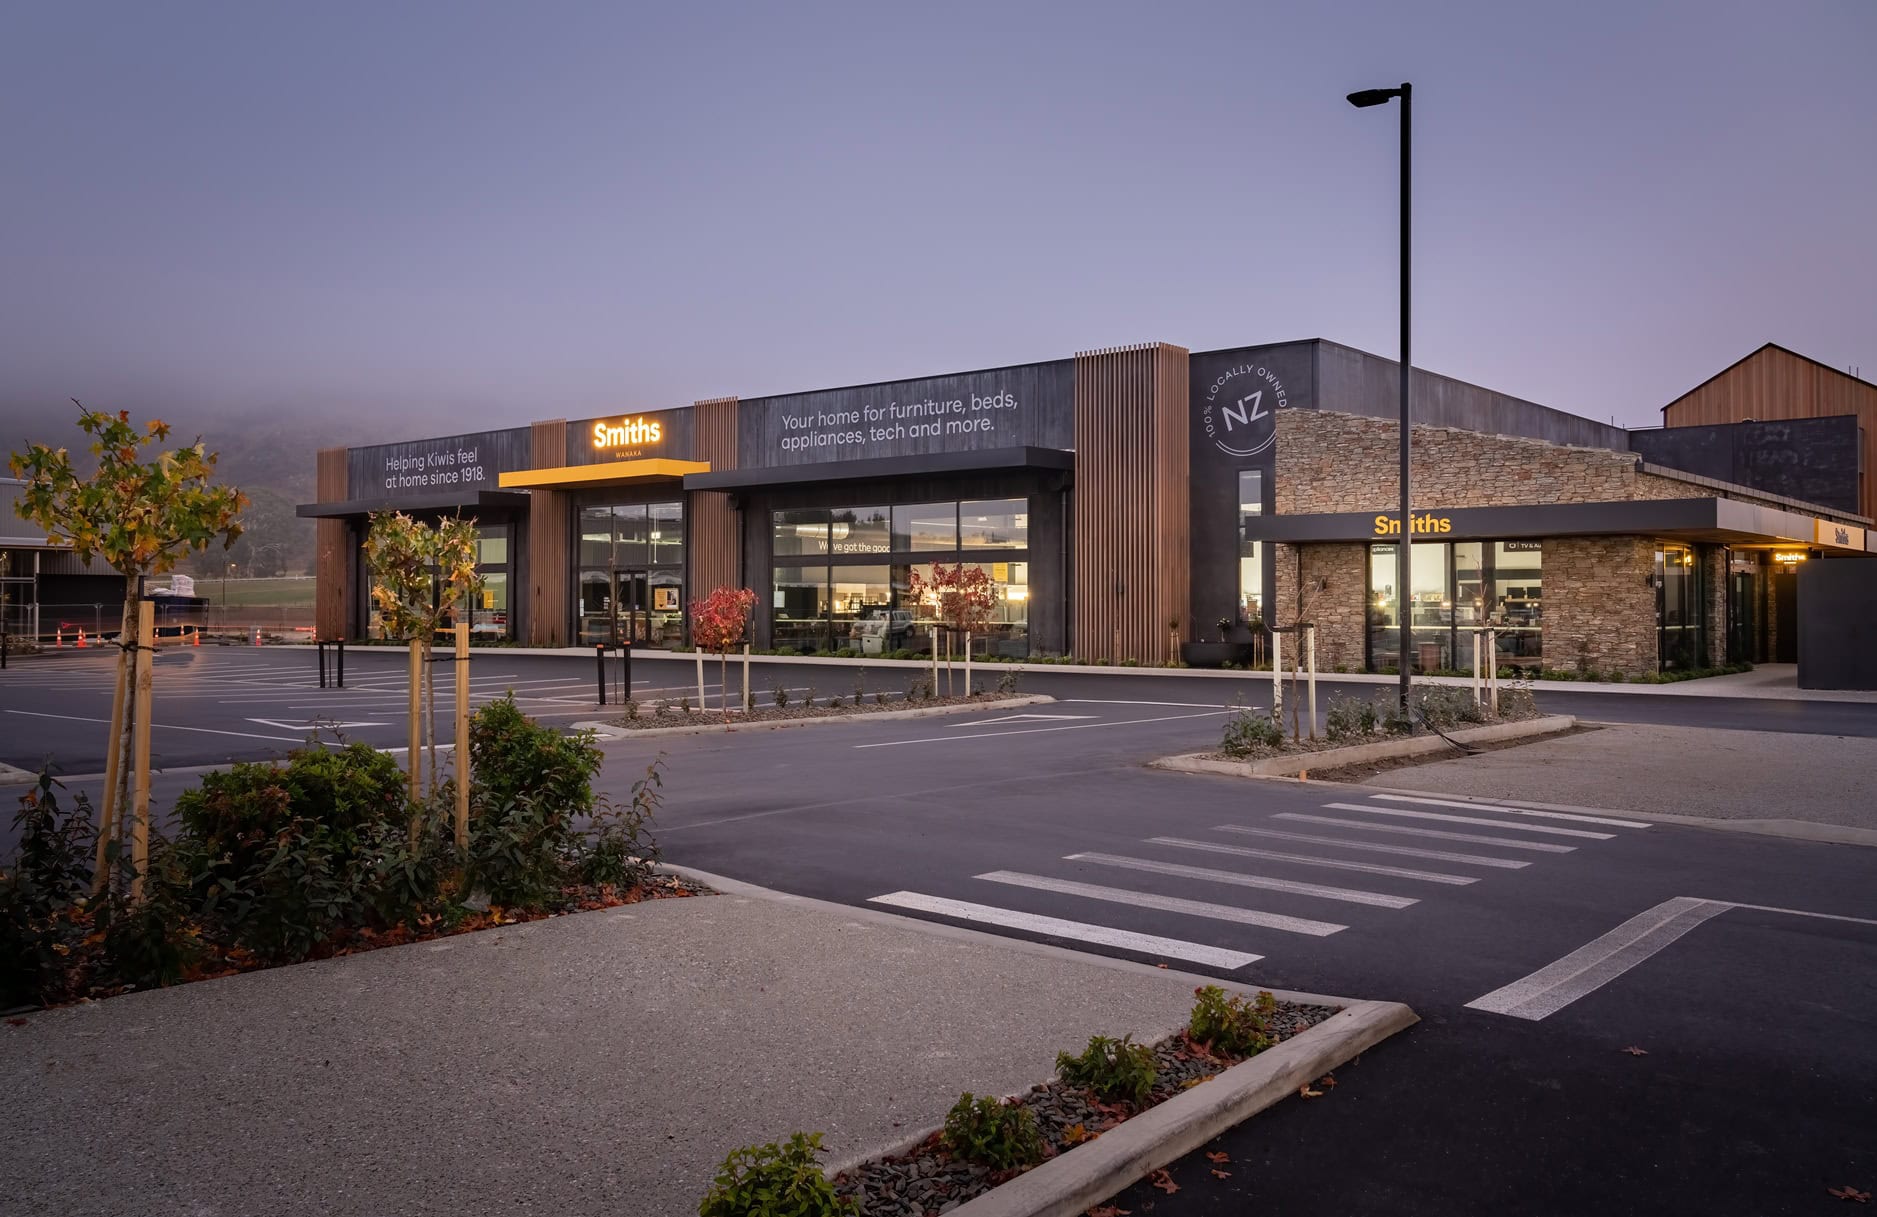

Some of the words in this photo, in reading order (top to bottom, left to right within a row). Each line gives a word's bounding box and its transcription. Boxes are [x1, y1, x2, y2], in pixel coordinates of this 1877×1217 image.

[1206, 364, 1254, 401] LOCALLY
[1257, 367, 1287, 408] OWNED
[782, 415, 814, 430] Your
[818, 411, 860, 427] home
[864, 404, 886, 422] for
[889, 399, 966, 420] furniture,
[971, 390, 1018, 411] beds,
[1203, 405, 1215, 438] 100%
[1221, 390, 1269, 432] NZ
[594, 416, 661, 448] Smiths
[781, 429, 866, 451] appliances,
[869, 422, 905, 441] tech
[909, 419, 941, 437] and
[946, 417, 995, 434] more.
[386, 454, 425, 472] Helping
[427, 450, 455, 467] Kiwis
[457, 447, 478, 464] feel
[615, 450, 642, 458] WANAKA
[385, 475, 397, 489] at
[399, 473, 428, 487] home
[430, 470, 459, 485] since
[460, 465, 486, 482] 1918.
[818, 540, 843, 551] Wve
[843, 542, 858, 554] got
[858, 542, 872, 552] the
